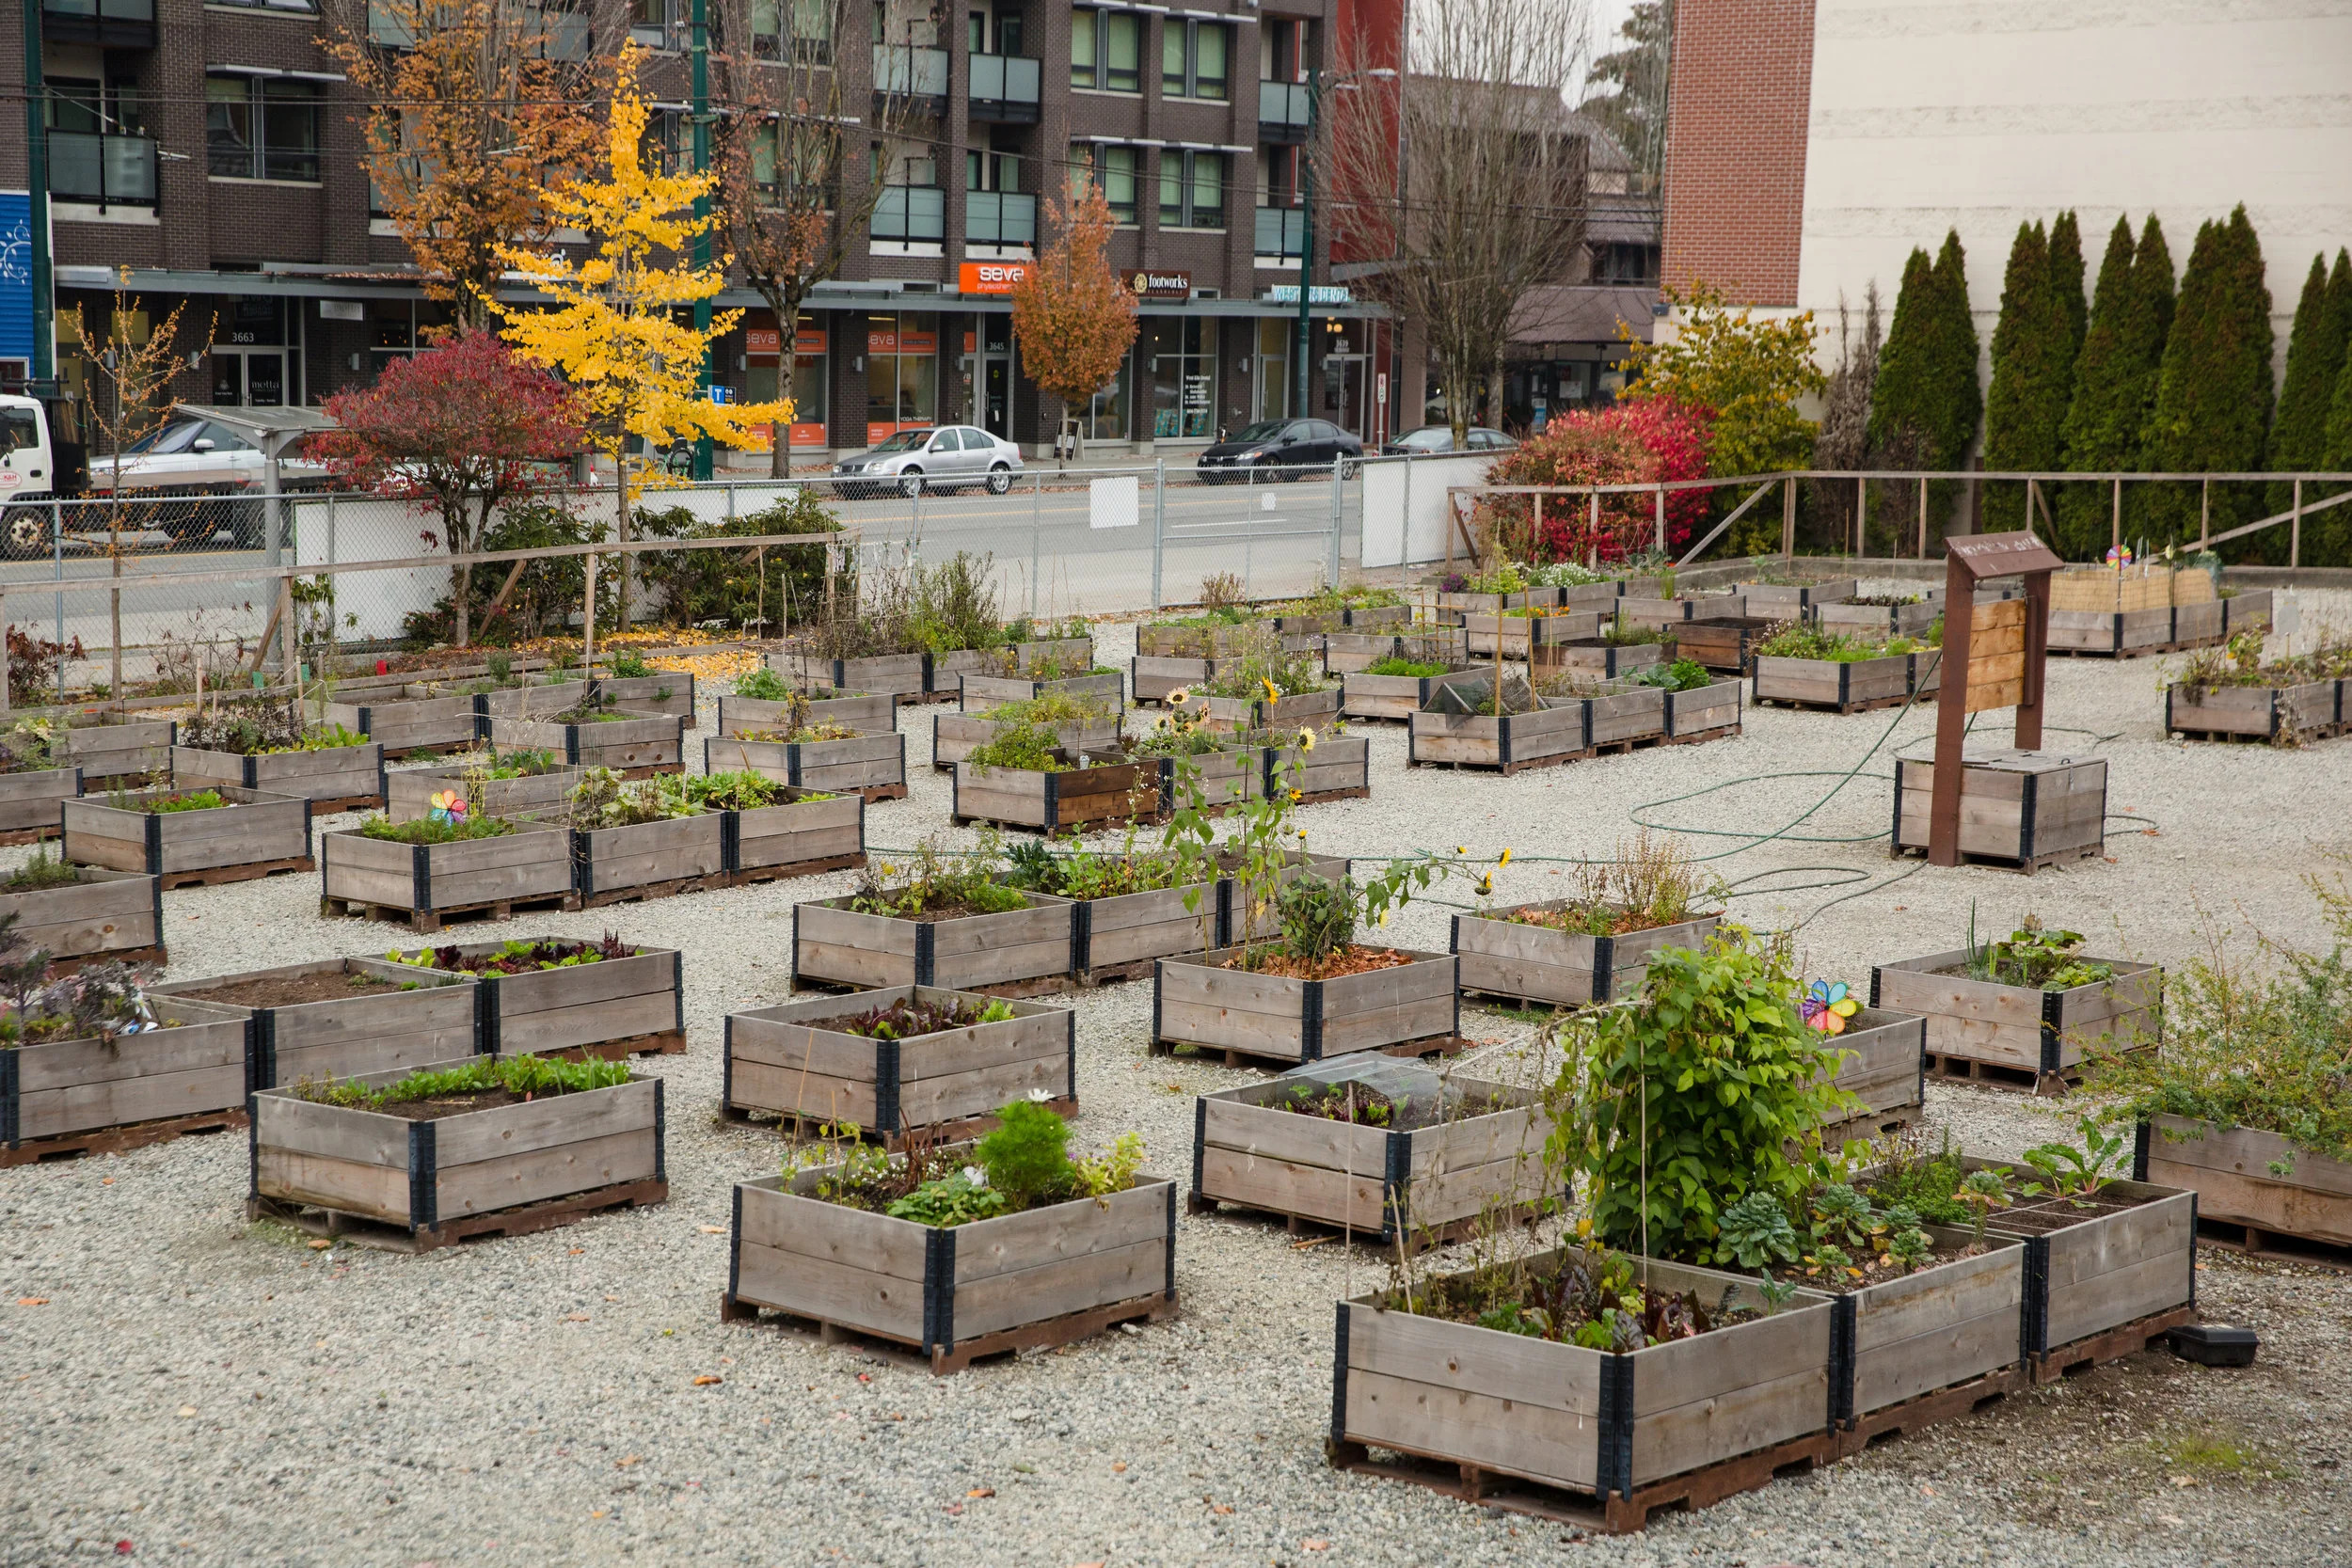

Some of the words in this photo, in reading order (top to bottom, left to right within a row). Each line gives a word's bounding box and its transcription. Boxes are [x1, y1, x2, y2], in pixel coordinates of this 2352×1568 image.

[979, 266, 1024, 282] seva
[1148, 273, 1188, 289] footworks
[1274, 286, 1299, 302] WEST
[231, 332, 254, 342] 3663
[868, 334, 895, 345] eva
[989, 341, 1005, 351] 3645
[714, 388, 723, 402] T
